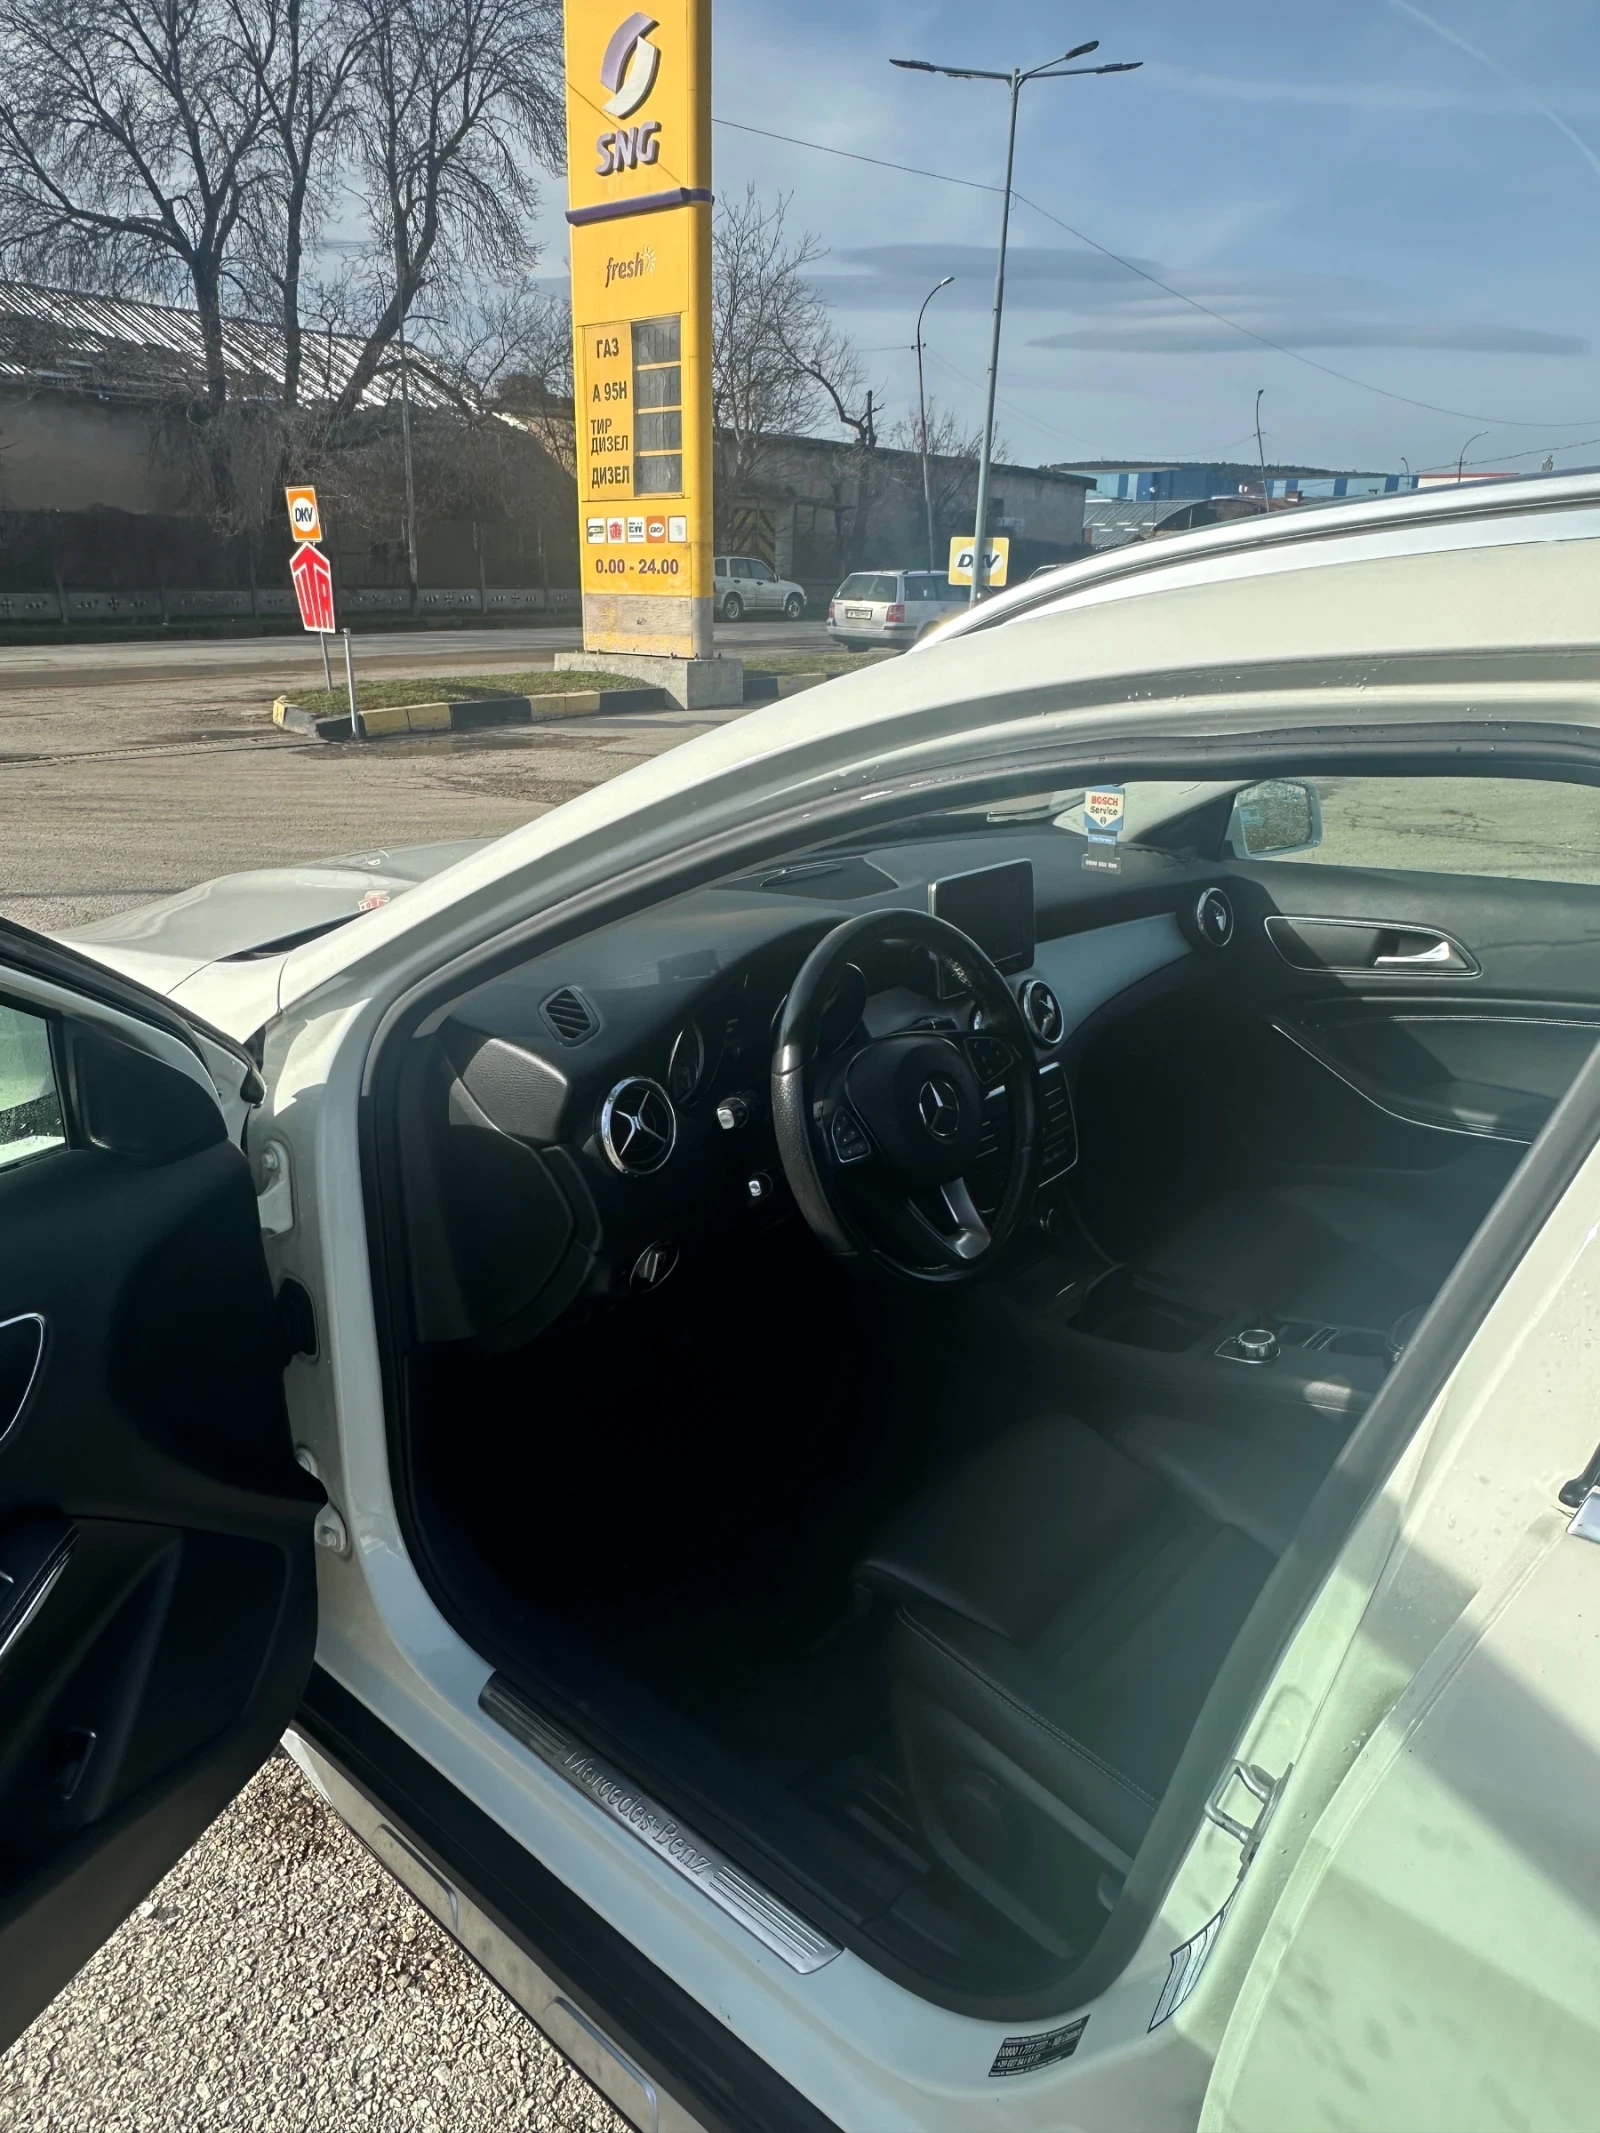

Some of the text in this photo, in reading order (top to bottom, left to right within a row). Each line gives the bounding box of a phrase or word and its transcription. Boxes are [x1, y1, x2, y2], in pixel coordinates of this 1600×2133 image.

[595, 121, 662, 176] SNG
[605, 252, 644, 288] fresh
[596, 337, 620, 359] ГАЗ
[590, 418, 612, 435] ТИР
[591, 435, 629, 456] ДИЗЕЛ
[591, 465, 630, 489] ДИЗЕЛ
[295, 507, 313, 522] DKV
[595, 558, 625, 574] 0.00
[638, 558, 679, 575] 24.00
[957, 554, 1000, 568] DV
[1090, 795, 1119, 806] BOSCH
[1090, 806, 1118, 816] Service
[561, 1750, 712, 1877] Mercedes-Benz
